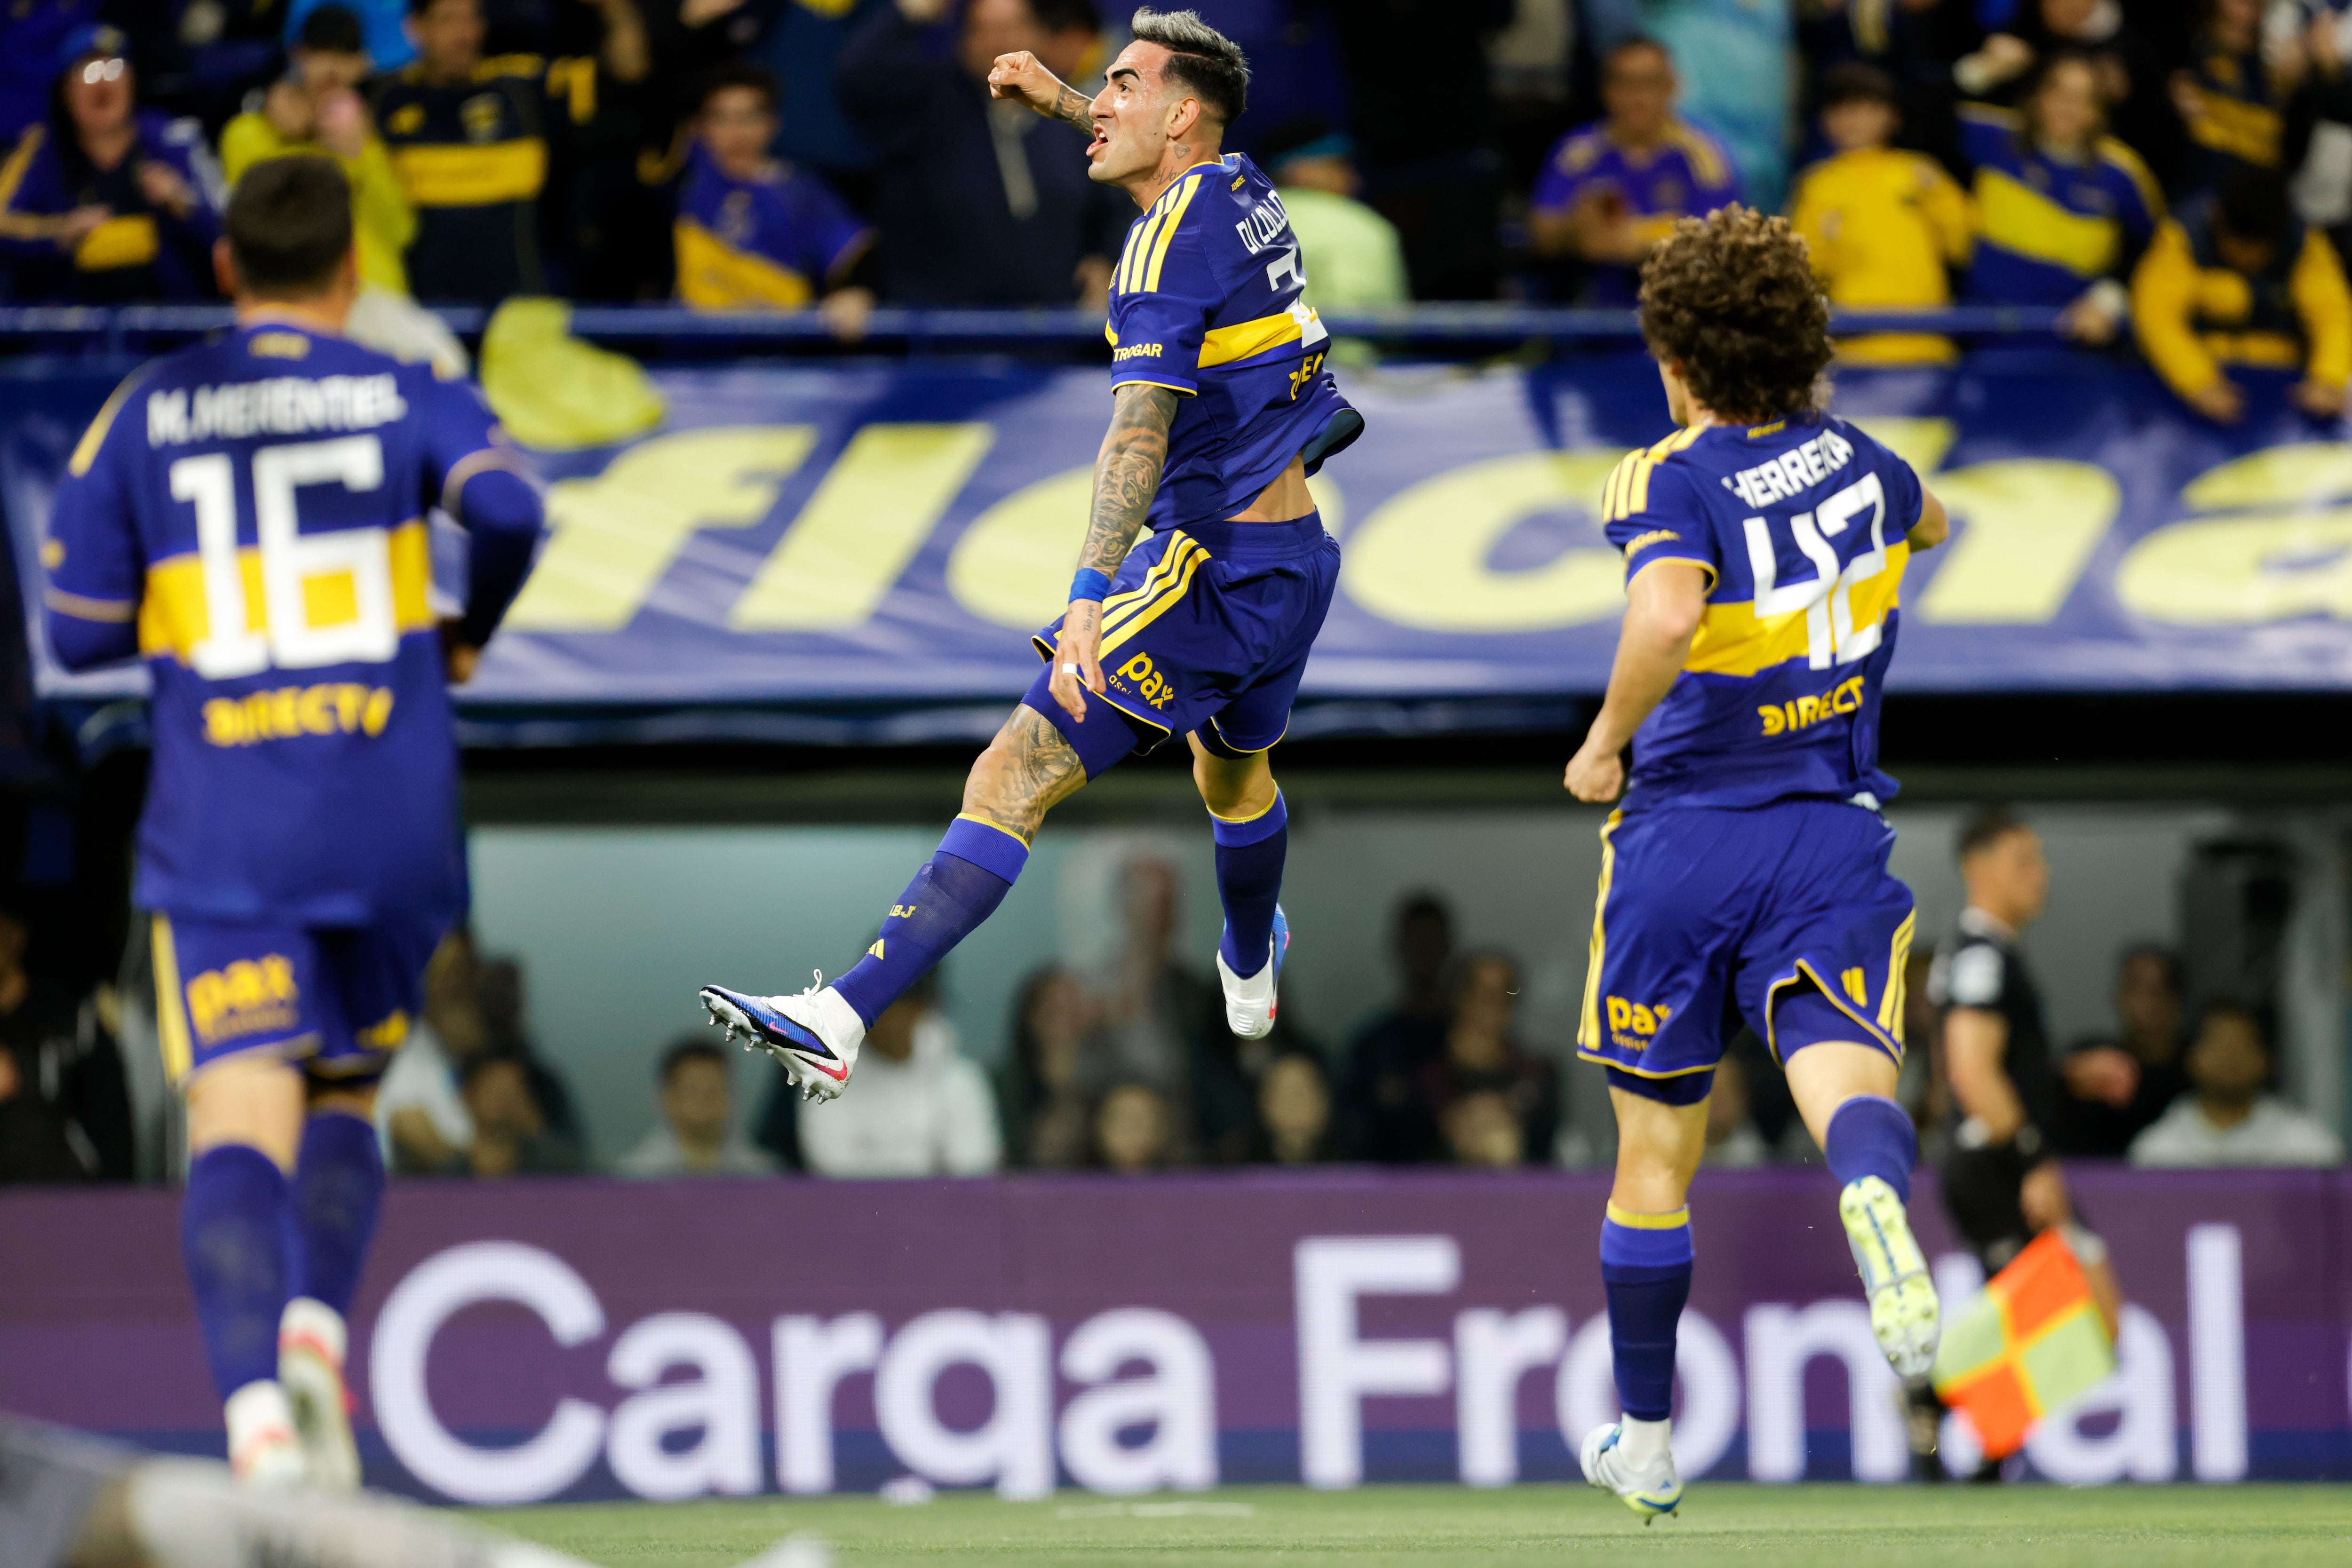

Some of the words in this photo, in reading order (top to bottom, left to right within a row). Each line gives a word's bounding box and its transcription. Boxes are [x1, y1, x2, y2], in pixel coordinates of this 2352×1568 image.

[1250, 189, 1289, 245] LOLLO
[1113, 343, 1162, 362] TROGAR
[169, 433, 399, 680] 16
[1742, 471, 1886, 670] 42
[1116, 651, 1174, 710] pax
[1757, 675, 1865, 736] DIRECT
